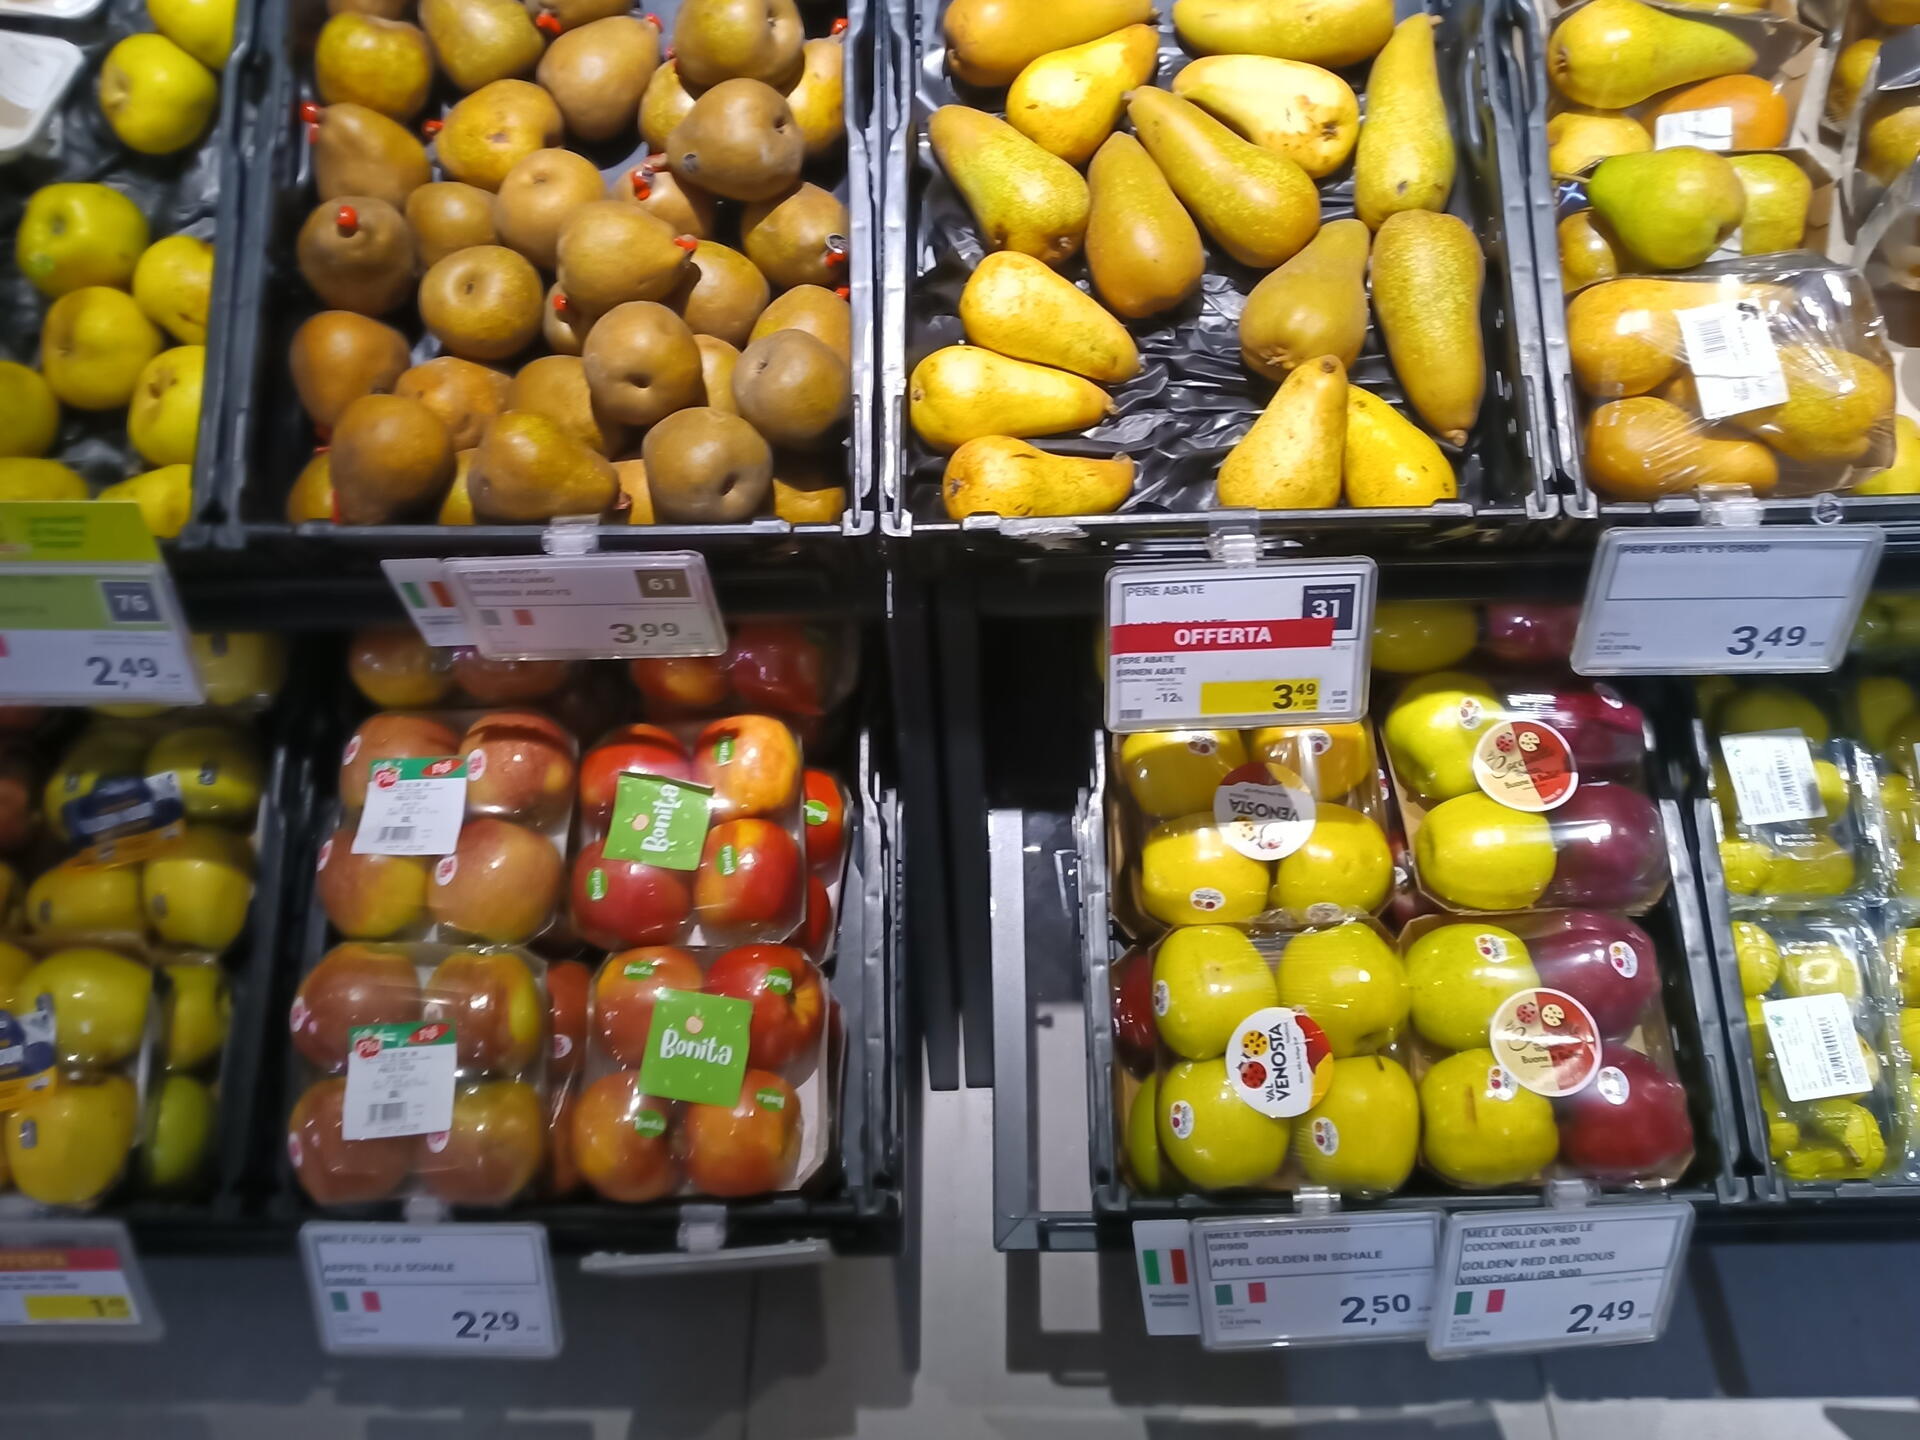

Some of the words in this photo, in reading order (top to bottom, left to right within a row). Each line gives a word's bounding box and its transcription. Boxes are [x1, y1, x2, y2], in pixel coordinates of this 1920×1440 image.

[648, 577, 676, 591] 61
[1127, 586, 1160, 597] PERE
[1163, 585, 1204, 596] ABATE
[113, 594, 150, 612] 76
[1311, 599, 1340, 619] 31
[609, 622, 680, 647] 3,99
[1173, 627, 1273, 646] OFFERTA
[1726, 626, 1808, 659] 3,49
[85, 656, 159, 690] 2,49
[1272, 683, 1317, 710] 3,49
[640, 783, 683, 852] Bonita
[1228, 798, 1300, 823] VENOSTA
[659, 1027, 733, 1066] Bonita
[1268, 1022, 1291, 1102] VENOSTA
[1265, 1083, 1276, 1103] VAL
[1466, 1228, 1499, 1238] MELE
[1579, 1223, 1595, 1232] LE
[1463, 1240, 1537, 1252] COCCINELLE
[1539, 1238, 1556, 1248] GR
[1559, 1237, 1581, 1246] 900
[1256, 1254, 1310, 1266] GOLDEN
[1313, 1253, 1327, 1263] IN
[1331, 1250, 1383, 1262] SCHALE
[1521, 1257, 1546, 1267] RED
[1549, 1251, 1616, 1265] DELICIOUS
[1339, 1294, 1411, 1326] 2,50
[1566, 1300, 1635, 1335] 2,49
[451, 1310, 521, 1342] 2,29
